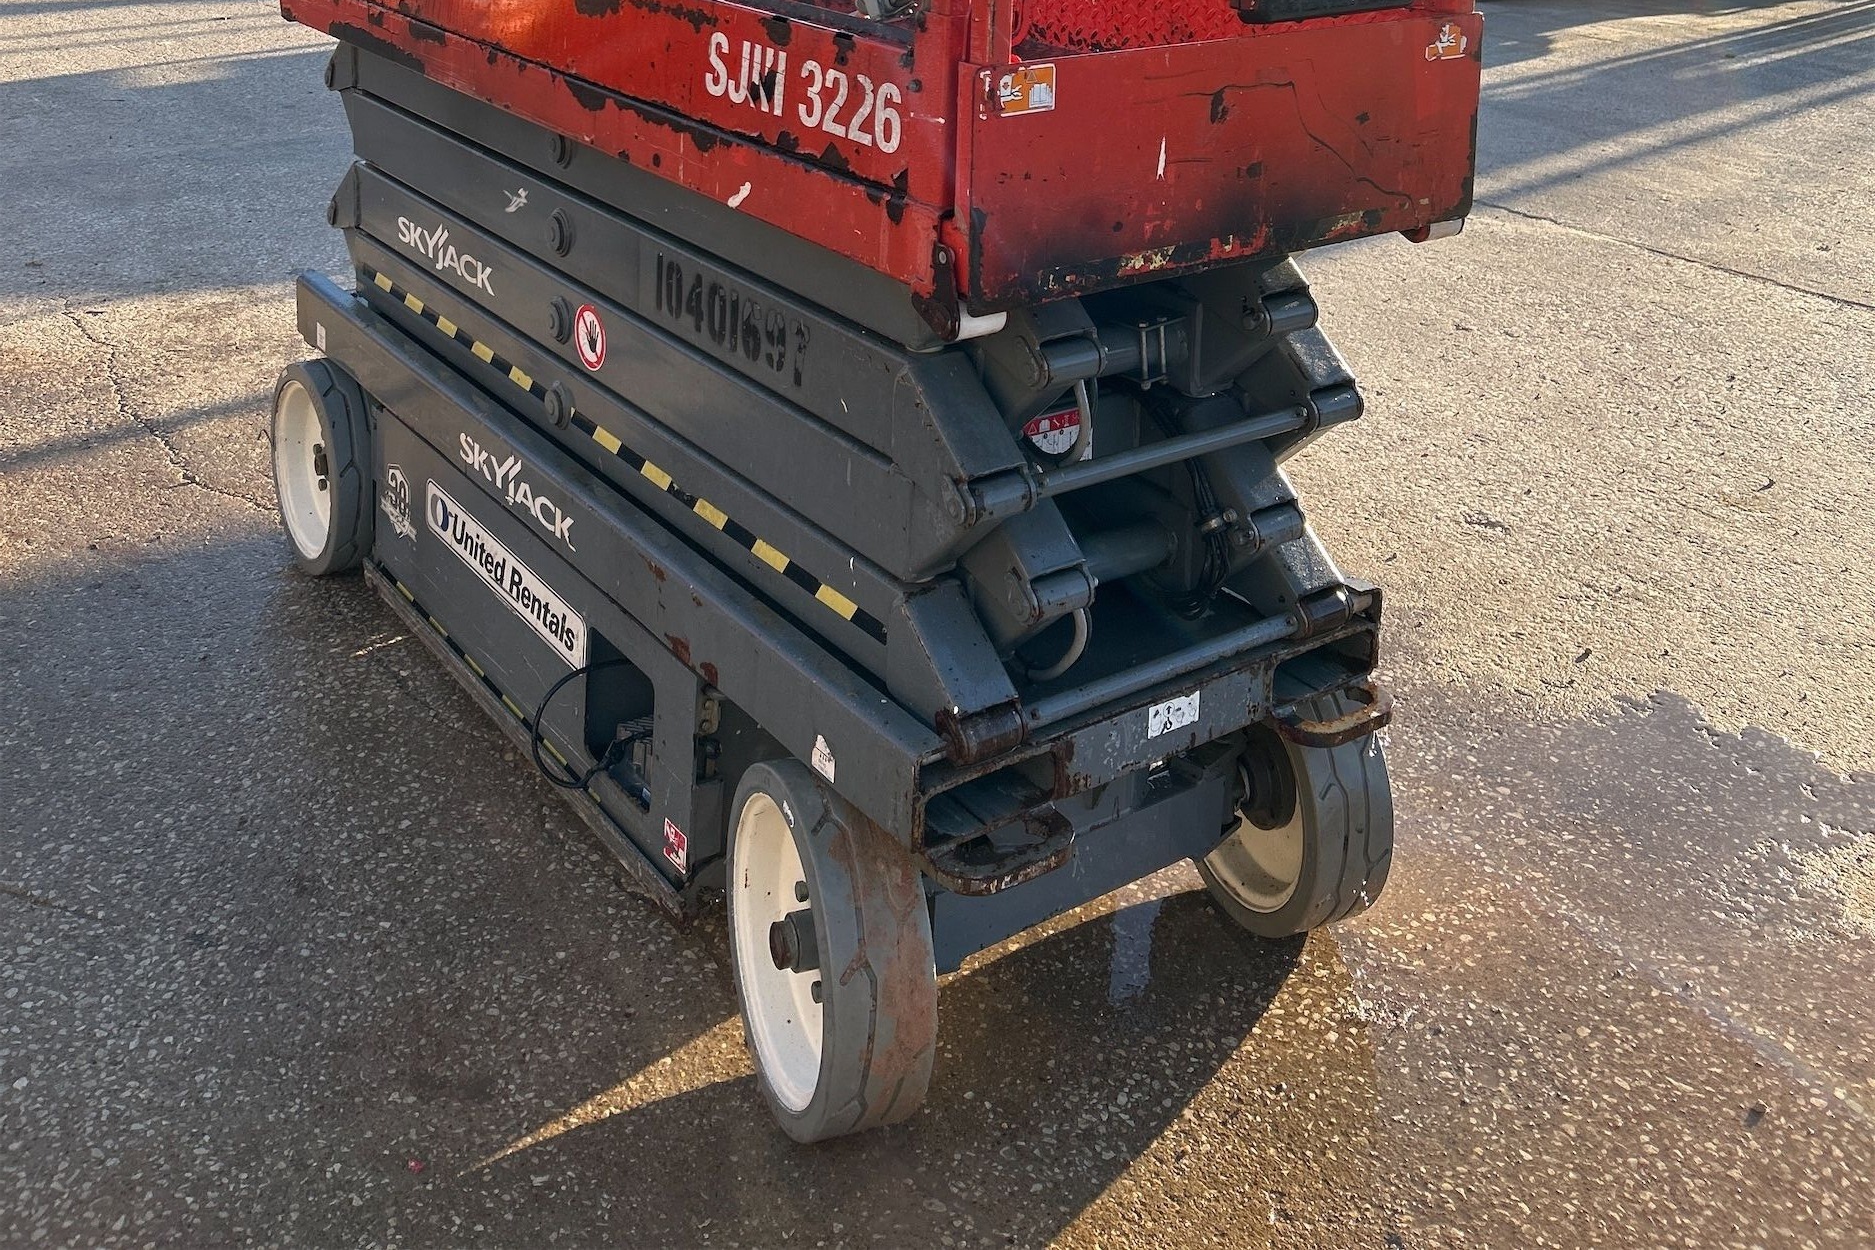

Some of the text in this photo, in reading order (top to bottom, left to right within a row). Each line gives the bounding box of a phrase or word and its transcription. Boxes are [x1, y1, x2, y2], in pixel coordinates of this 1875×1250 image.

[798, 60, 902, 154] 3226
[398, 216, 496, 297] SKYJACK
[460, 432, 576, 552] SKYJACK
[452, 513, 506, 586] United
[509, 565, 576, 652] Rentals
